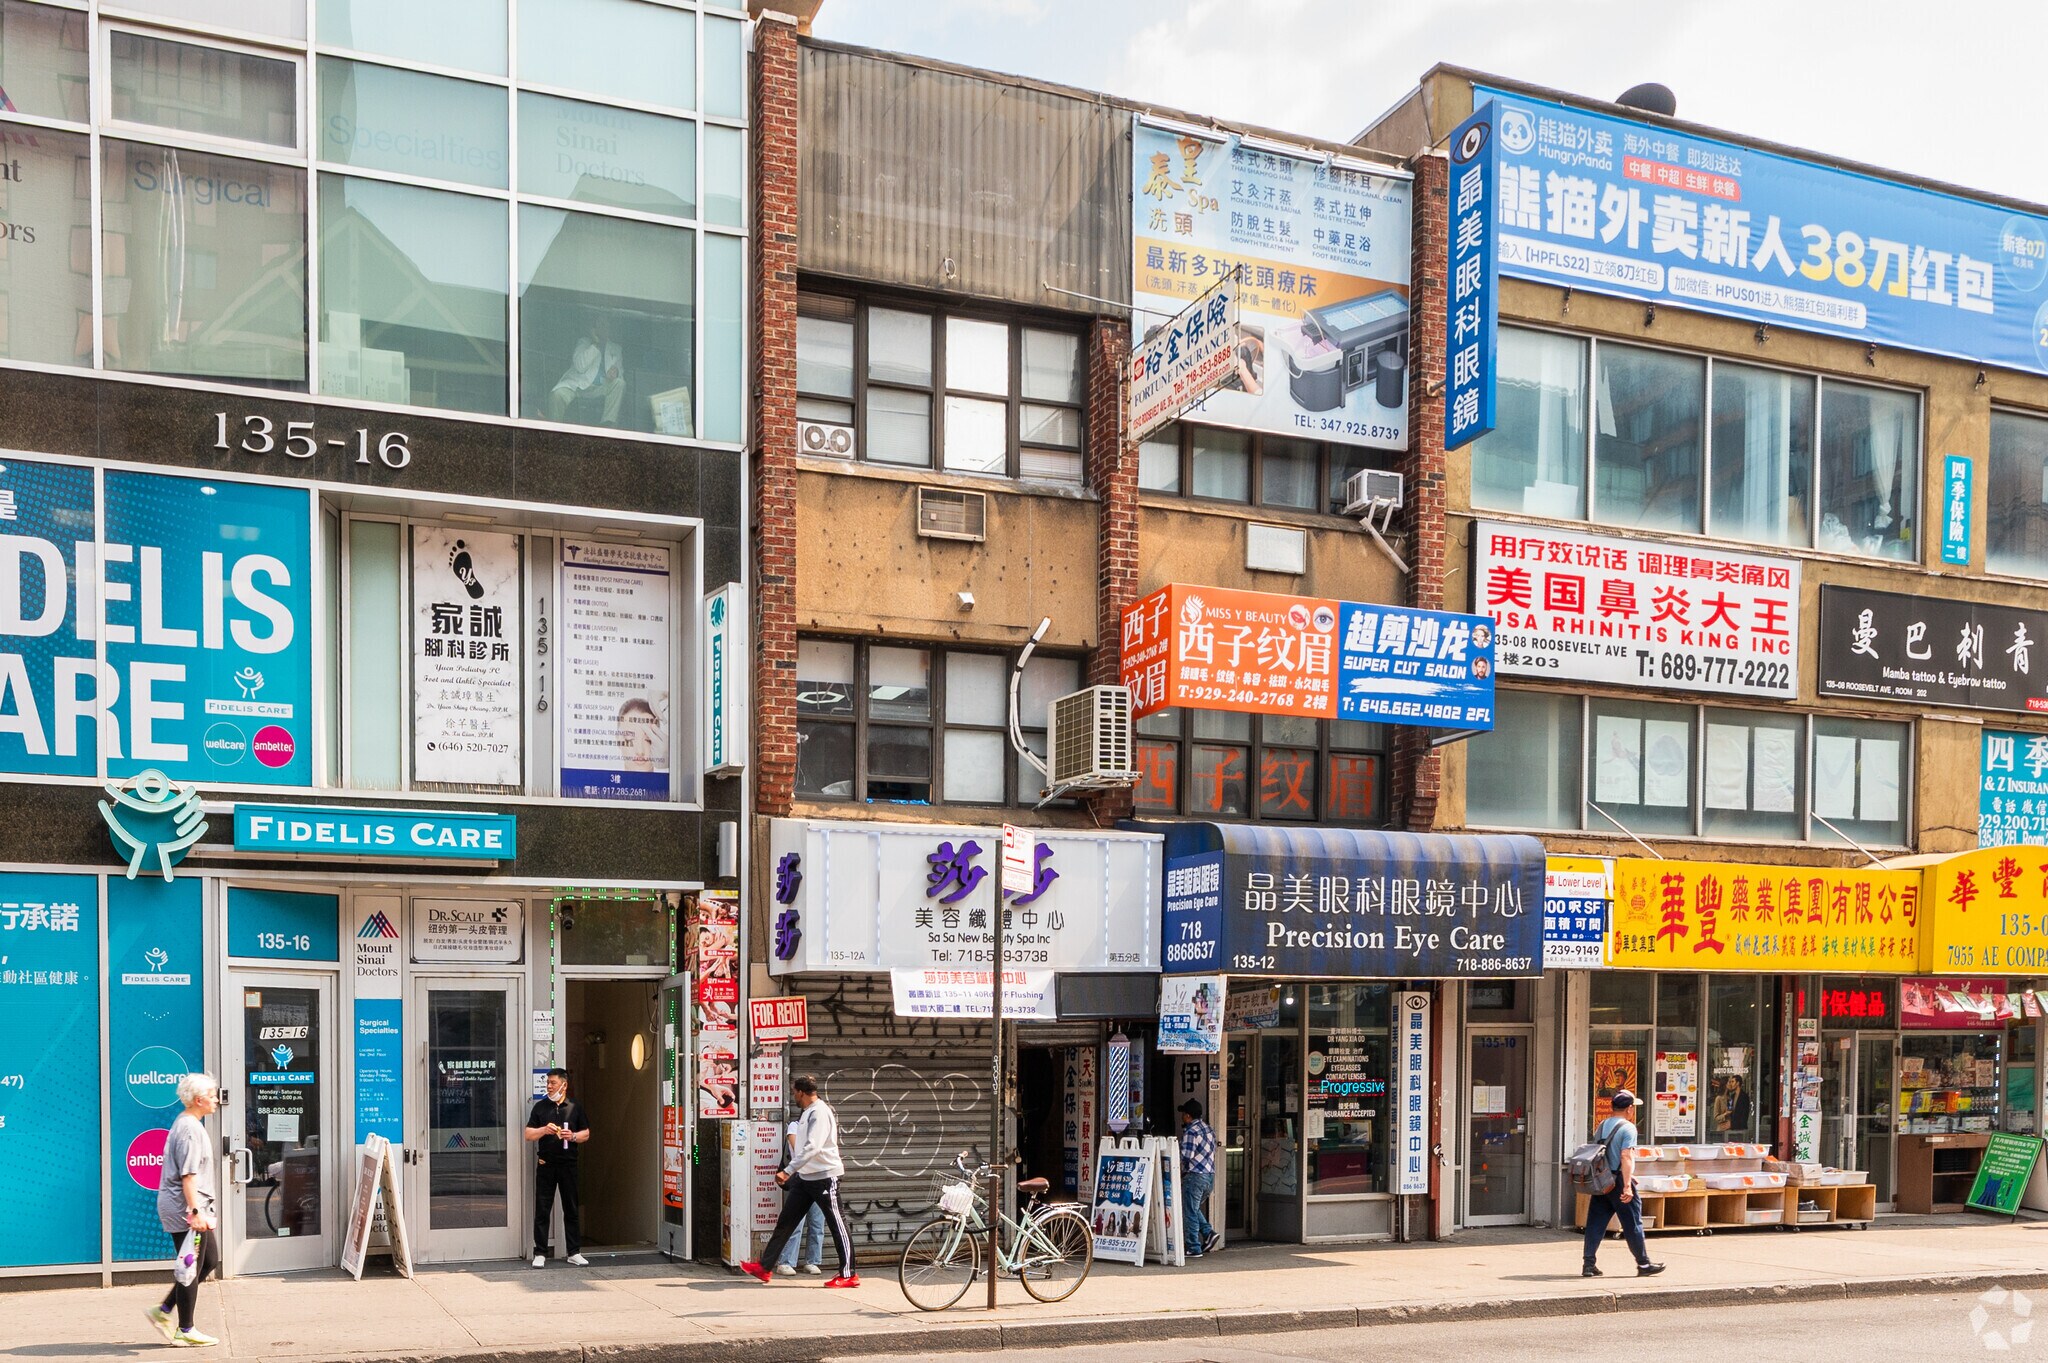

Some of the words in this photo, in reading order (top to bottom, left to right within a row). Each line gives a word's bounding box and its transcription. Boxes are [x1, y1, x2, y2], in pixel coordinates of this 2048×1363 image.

[328, 115, 502, 172] Specialties
[556, 126, 620, 156] Sinai
[1538, 116, 1613, 157] 熊猫外卖
[1538, 146, 1612, 171] HungryPanda
[1623, 133, 1680, 164] 海外中餐
[1687, 147, 1743, 177] 即刻送达
[555, 153, 647, 188] Doctors
[133, 159, 272, 208] Surgical
[1187, 188, 1220, 214] Spa
[1452, 163, 1483, 436] 晶美眼科眼鏡
[1133, 366, 1174, 408] FORTUNE
[1174, 327, 1231, 378] INSURANCE
[1294, 414, 1316, 428] TEL:
[1319, 418, 1400, 440] 347.925.8739
[213, 412, 412, 470] 135-16
[1489, 533, 1628, 571] 用疗效说话
[1638, 551, 1790, 590] 调理鼻炎痛风
[1486, 565, 1790, 637] 美国鼻炎大王
[431, 602, 503, 639] 家誠
[1205, 607, 1232, 621] MISS
[1234, 609, 1243, 621] Y
[1245, 611, 1288, 626] BEAUTY
[1343, 610, 1470, 660] 超剪沙龙
[1490, 610, 1538, 631] USA
[1552, 615, 1668, 645] RHINITIS
[1681, 629, 1739, 651] KING
[1752, 636, 1790, 656] INC
[424, 638, 510, 662] 腳科診所
[1178, 621, 1332, 676] 西子纹眉
[1531, 636, 1602, 658] ROOSEVELT
[1604, 643, 1628, 658] AVE
[1343, 655, 1389, 673] SUPER
[1393, 659, 1420, 676] CUT
[1424, 661, 1467, 680] SALON
[1635, 650, 1655, 678] T:
[1660, 652, 1790, 690] 689-777-2222
[1882, 666, 1910, 681] Mamba
[1911, 670, 1937, 684] tattoo
[1938, 673, 1946, 684] &
[1947, 674, 1981, 689] Eyebrow
[1982, 677, 2007, 690] tattoo
[1178, 684, 1295, 707] T:929-240-2768
[1825, 680, 1845, 690] 135-08
[1846, 681, 1879, 694] ROOSEVELT
[1894, 686, 1913, 696] ROOM
[1916, 688, 1928, 698] 202
[1342, 698, 1355, 713] T:
[1359, 699, 1461, 721] 646.662.4802
[1465, 705, 1491, 723] 2FL
[205, 732, 245, 751] wellcare
[438, 743, 463, 753] (646)
[466, 743, 509, 754] 520-7027
[602, 786, 647, 797] 917.285.2681
[1557, 877, 1581, 889] Lower
[1582, 877, 1602, 889] Level
[1166, 898, 1193, 912] Precision
[1193, 897, 1204, 911] Eye
[1204, 896, 1219, 909] Care
[1245, 872, 1523, 919] 晶美眼科眼鏡中心
[1584, 900, 1601, 915] SF
[428, 923, 508, 936] 纽约第一头皮管理
[928, 933, 941, 943] Sa
[943, 933, 955, 943] Sa
[957, 933, 981, 944] New
[1016, 934, 1035, 946] Spa
[1036, 934, 1051, 944] Inc
[1180, 920, 1203, 940] 718
[1267, 922, 1389, 950] Precision
[1393, 926, 1441, 957] Eye
[1449, 928, 1505, 951] Care
[257, 932, 311, 952] 135-16
[356, 943, 393, 953] Mount
[1166, 940, 1216, 962] 8868637
[1544, 944, 1600, 956] -239-9149
[356, 955, 386, 965] Sinai
[829, 950, 866, 961] 135-12A
[931, 949, 952, 962] Tel:
[957, 949, 1049, 963] 718-59-3738
[1232, 954, 1275, 969] 135-12
[1456, 957, 1532, 972] 718-886-8637
[1947, 945, 1975, 967] 7955
[1981, 946, 1999, 966] AE
[356, 966, 399, 977] Doctors
[1010, 990, 1044, 1001] Flushing
[359, 1019, 390, 1028] Surgical
[753, 1003, 774, 1026] FOR
[775, 1001, 804, 1025] RENT
[262, 1027, 308, 1039] 135-16
[359, 1027, 399, 1035] Specialties
[1481, 1037, 1516, 1049] 135-10
[1330, 1064, 1362, 1072] EYEGLASSES
[1333, 1055, 1369, 1063] EXAMINATIONS
[1347, 1073, 1367, 1081] LENSES
[1408, 1012, 1423, 1173] 晶美眼科眼鏡中心
[257, 1107, 304, 1115] 888-820-9318
[1350, 1109, 1376, 1118] ACCEPTED
